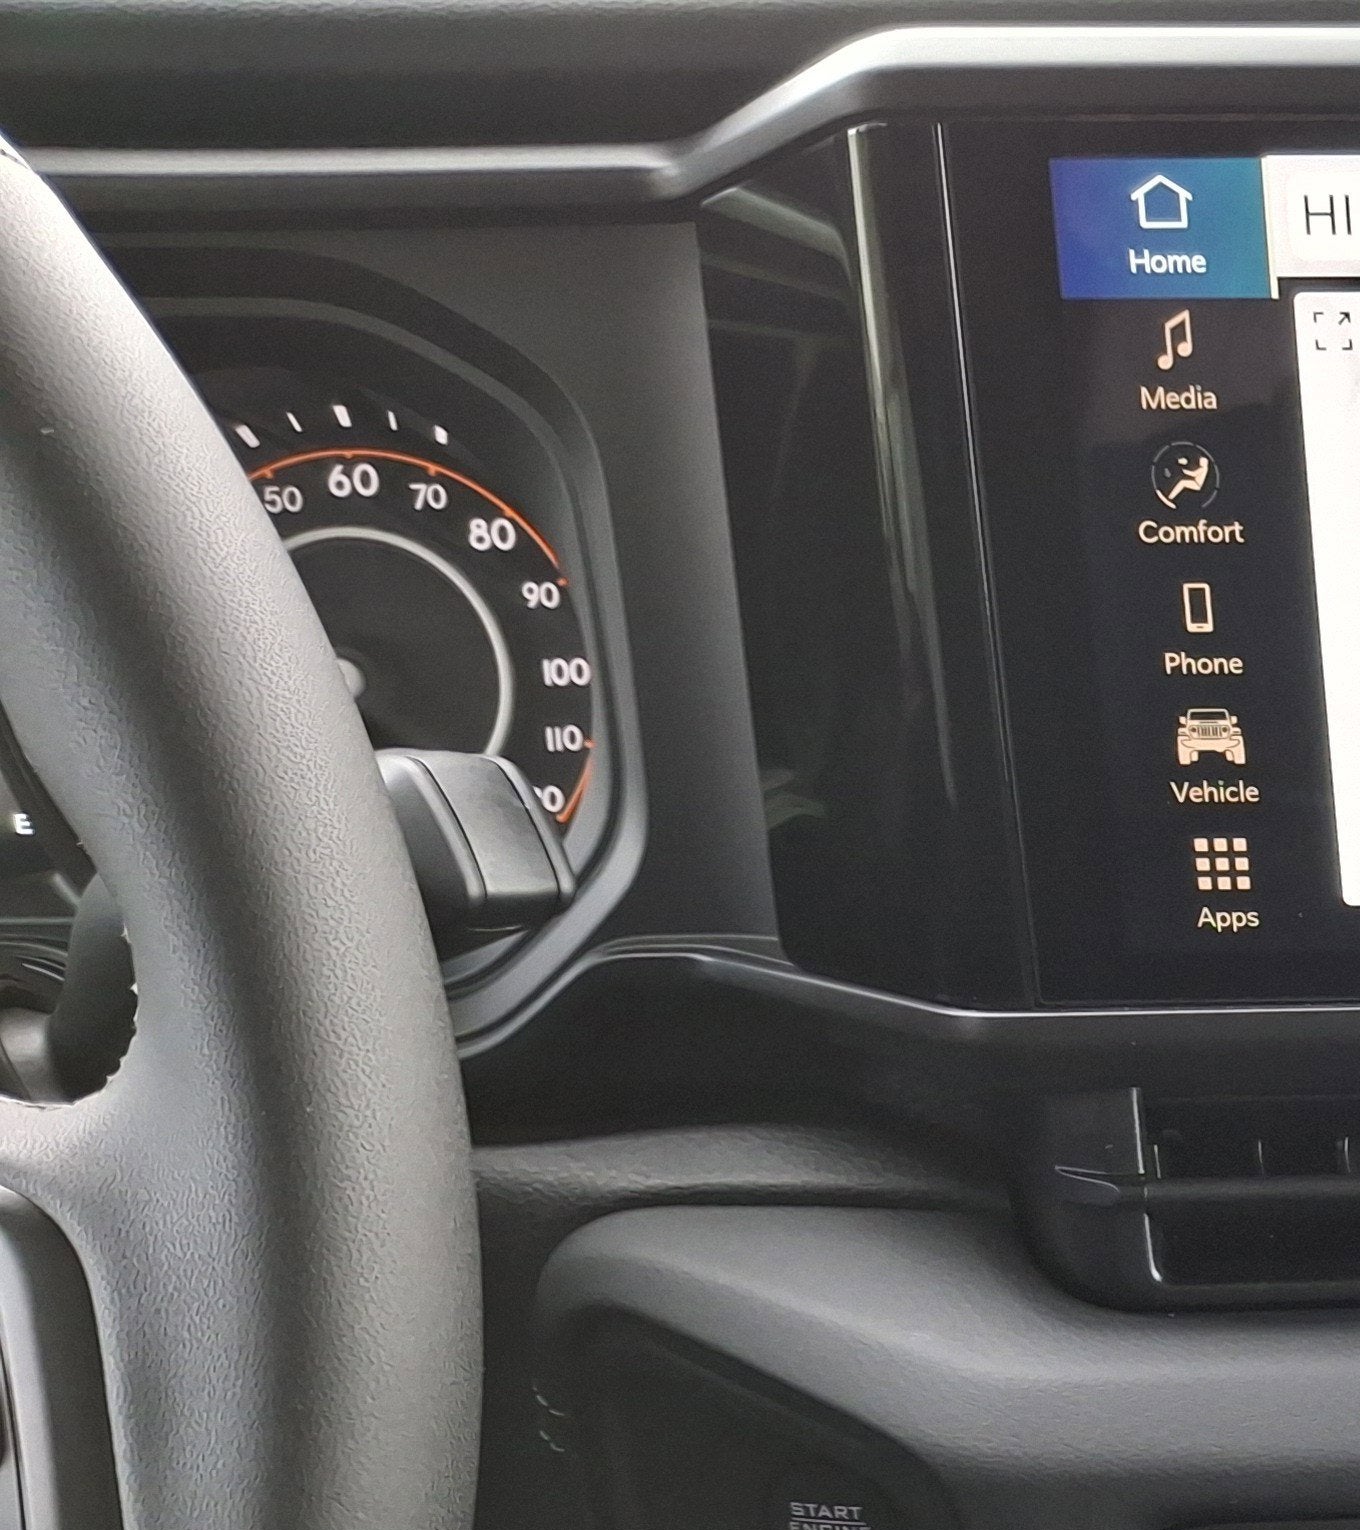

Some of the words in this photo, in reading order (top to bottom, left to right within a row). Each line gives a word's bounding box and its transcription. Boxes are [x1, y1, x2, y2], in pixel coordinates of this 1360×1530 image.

[1303, 195, 1353, 236] HI
[1128, 250, 1207, 275] Home
[1140, 386, 1218, 411] Media
[328, 462, 380, 497] 60
[263, 485, 303, 514] 50
[409, 482, 448, 511] 70
[468, 517, 516, 551] 80
[1138, 519, 1245, 546] Comfort
[521, 581, 561, 609] 90
[542, 656, 591, 687] 100
[1163, 650, 1244, 676] Phone
[545, 724, 585, 752] 110
[1170, 780, 1260, 805] Vehicle
[12, 813, 36, 835] E
[1197, 906, 1260, 932] Apps
[790, 1502, 863, 1520] START
